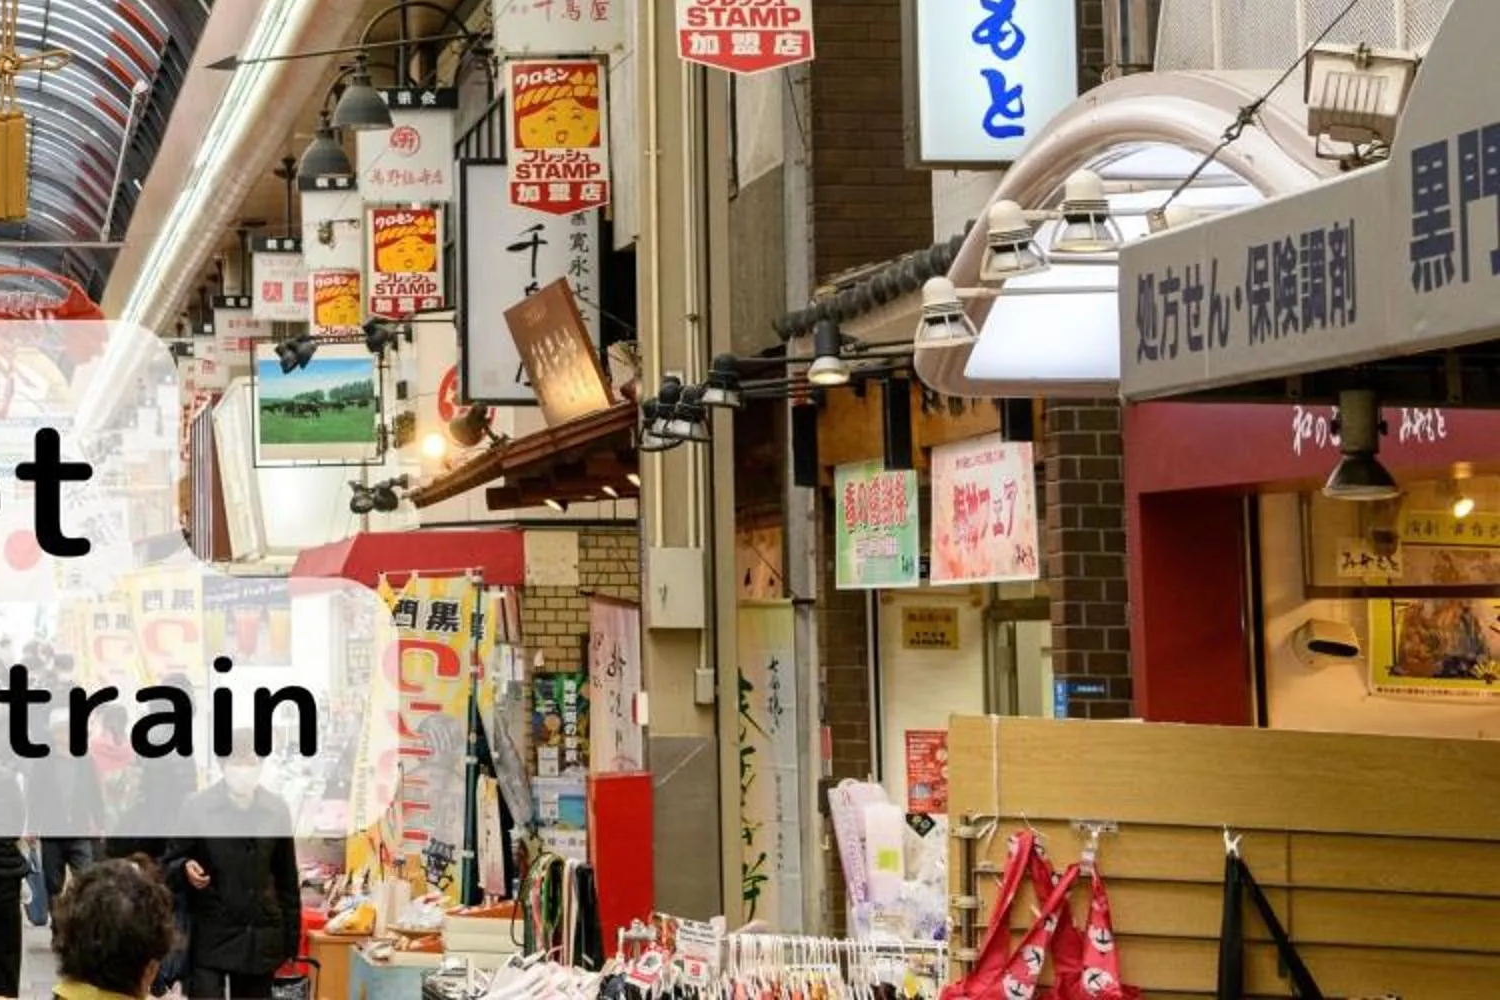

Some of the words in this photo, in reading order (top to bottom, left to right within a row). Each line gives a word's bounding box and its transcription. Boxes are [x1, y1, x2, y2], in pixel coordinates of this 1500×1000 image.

[687, 7, 802, 28] STAMP
[688, 32, 804, 57] 加盟店
[515, 67, 570, 90] クロモン
[523, 149, 591, 163] フレッシュ
[515, 162, 602, 180] STAMP
[516, 183, 602, 203] 加盟店
[374, 213, 416, 228] クロモン
[374, 283, 438, 296] STAMP
[1136, 216, 1358, 364] 処方せん・保険調剤
